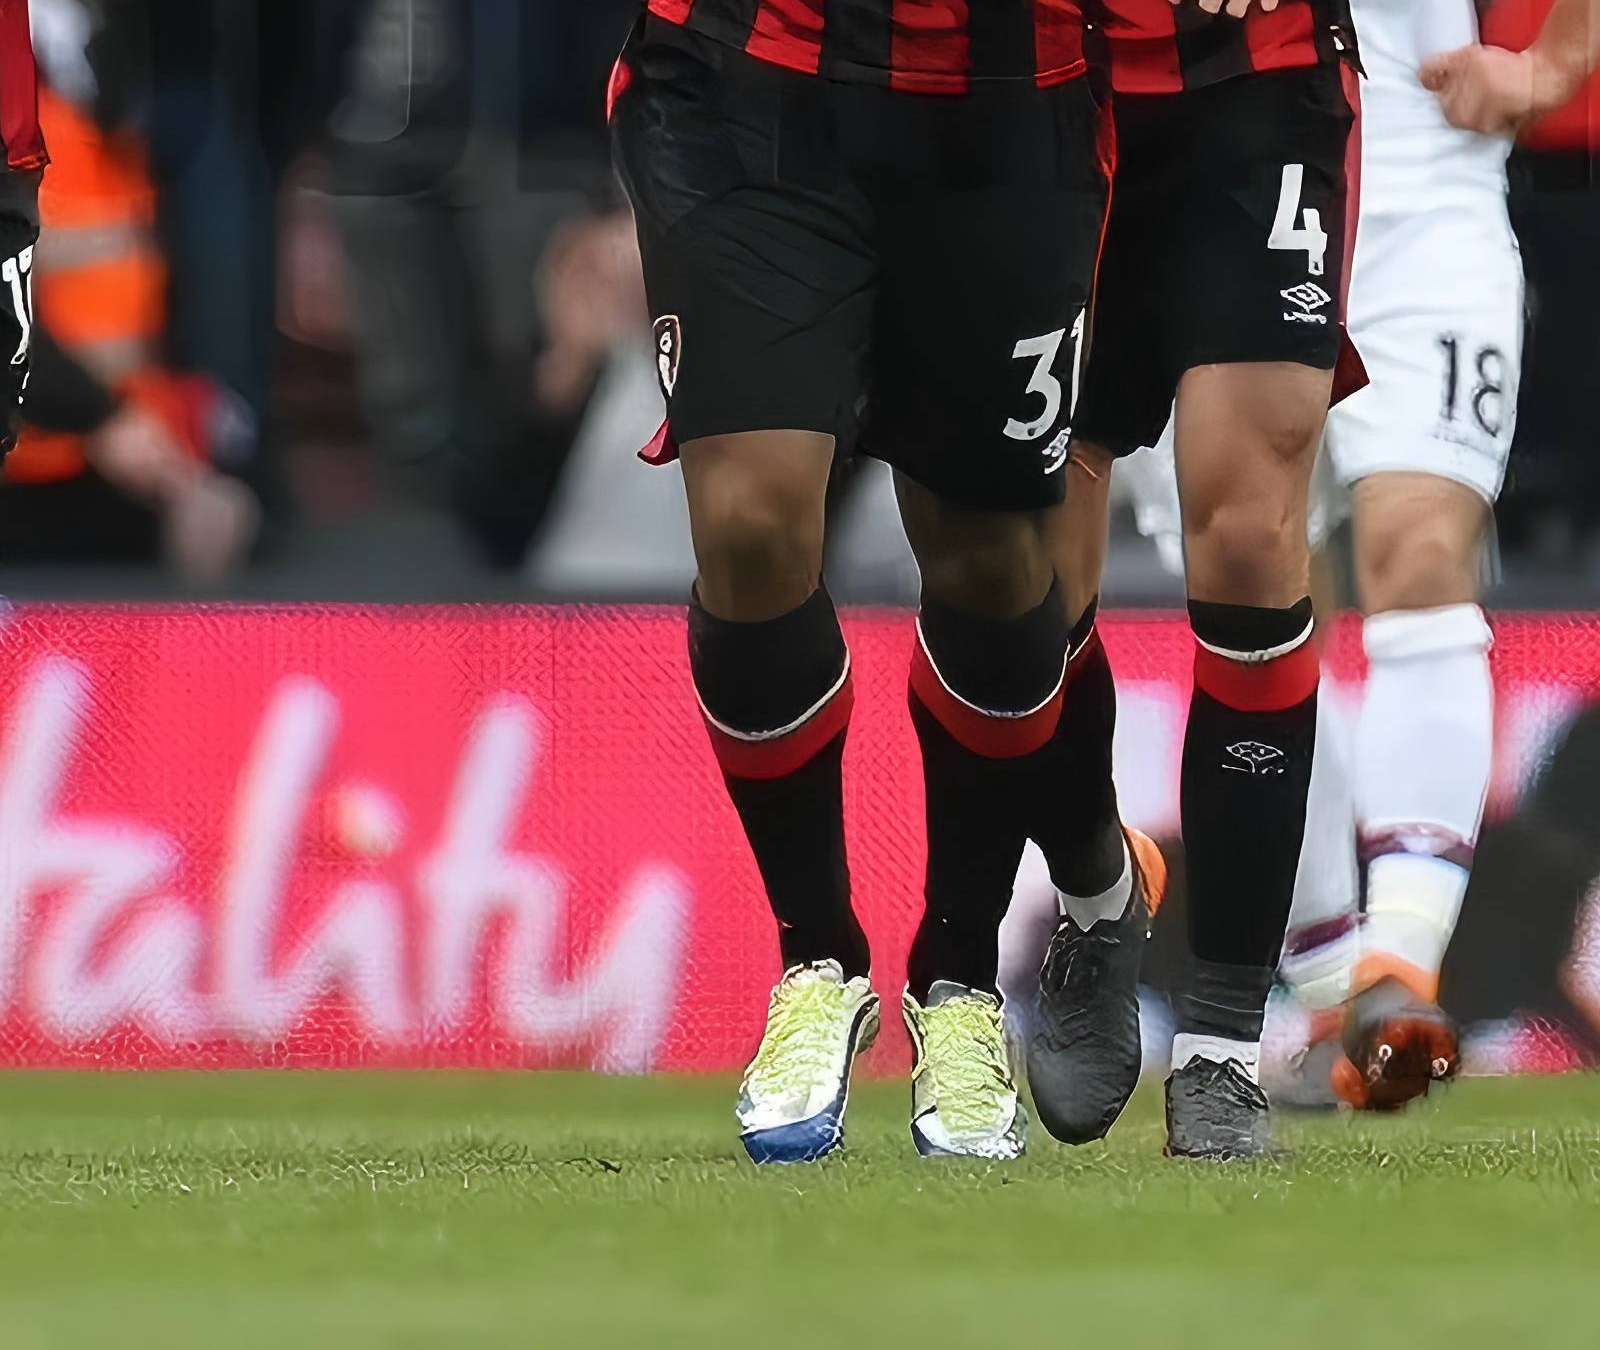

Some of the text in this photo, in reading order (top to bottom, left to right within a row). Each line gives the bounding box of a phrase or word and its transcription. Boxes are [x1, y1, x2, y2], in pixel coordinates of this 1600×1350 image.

[1266, 162, 1329, 277] 4
[1002, 306, 1086, 441] 31
[1437, 331, 1505, 438] 18
